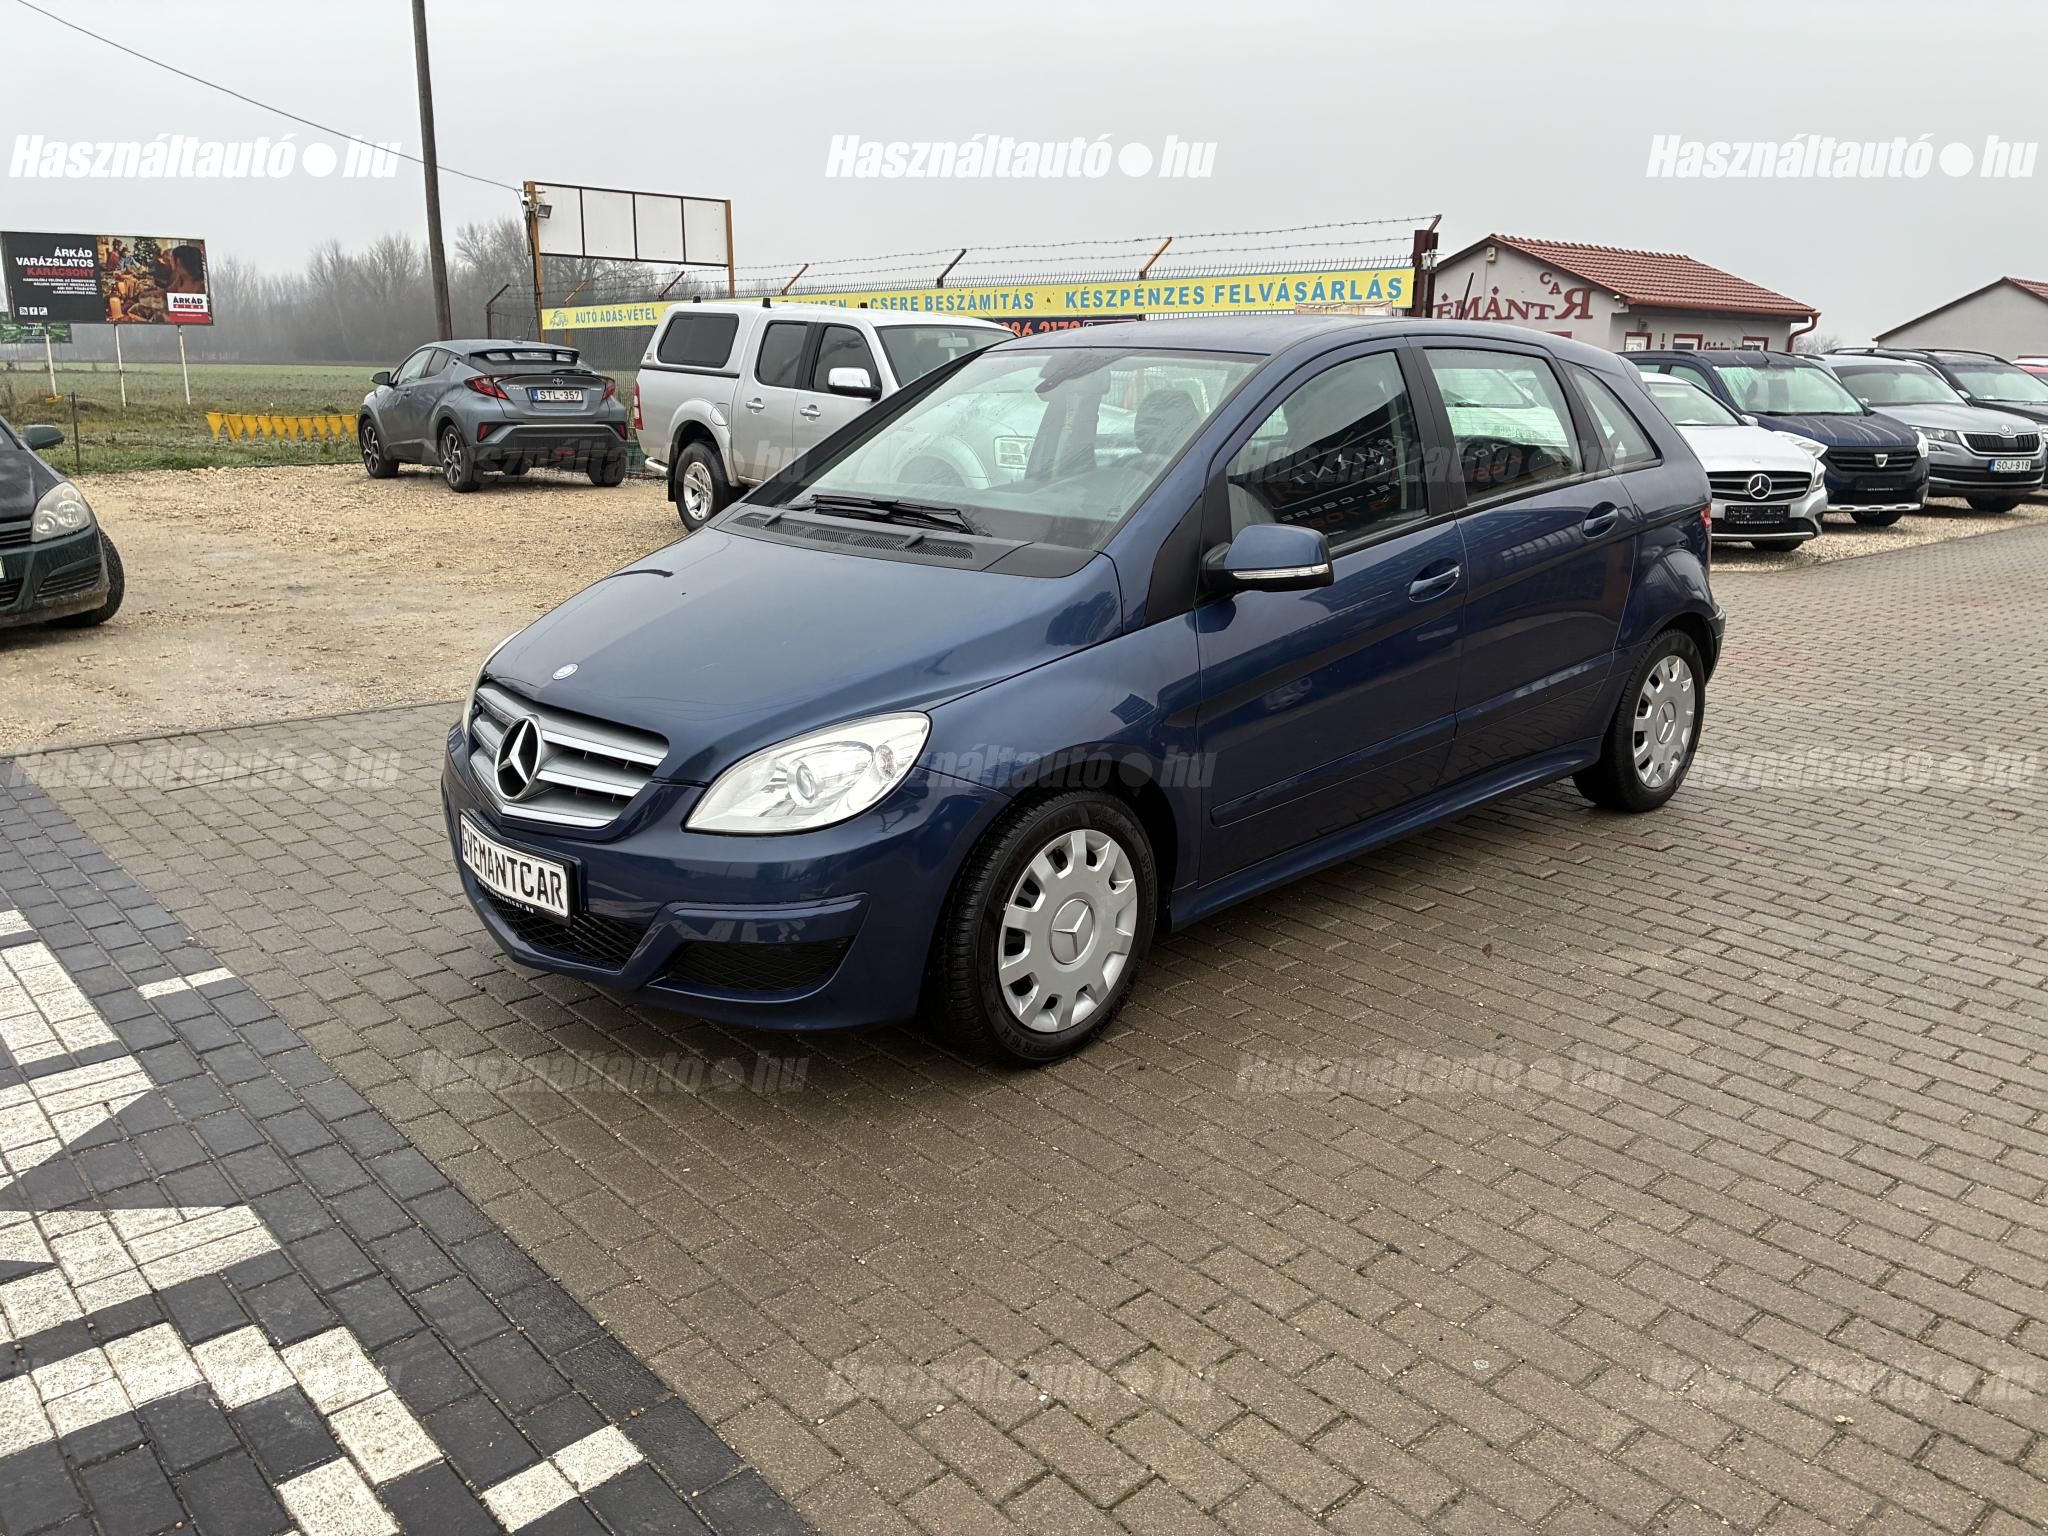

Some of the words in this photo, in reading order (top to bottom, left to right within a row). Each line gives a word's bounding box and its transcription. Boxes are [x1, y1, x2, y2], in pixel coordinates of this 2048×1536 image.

[54, 247, 93, 258] ÁRKÁD
[15, 256, 94, 268] VARÁZSLATOS
[575, 309, 598, 324] AUTÓ
[869, 295, 919, 312] CSERE
[924, 289, 1034, 312] BESZÁMÍTÁS
[1065, 284, 1205, 309] KÉSZPÉNZES
[1213, 273, 1402, 304] FELVÁSÁRLÁS
[540, 390, 580, 400] STL-357
[1996, 461, 2030, 470] SOJ-918
[462, 824, 564, 909] GYEMANTCAR
